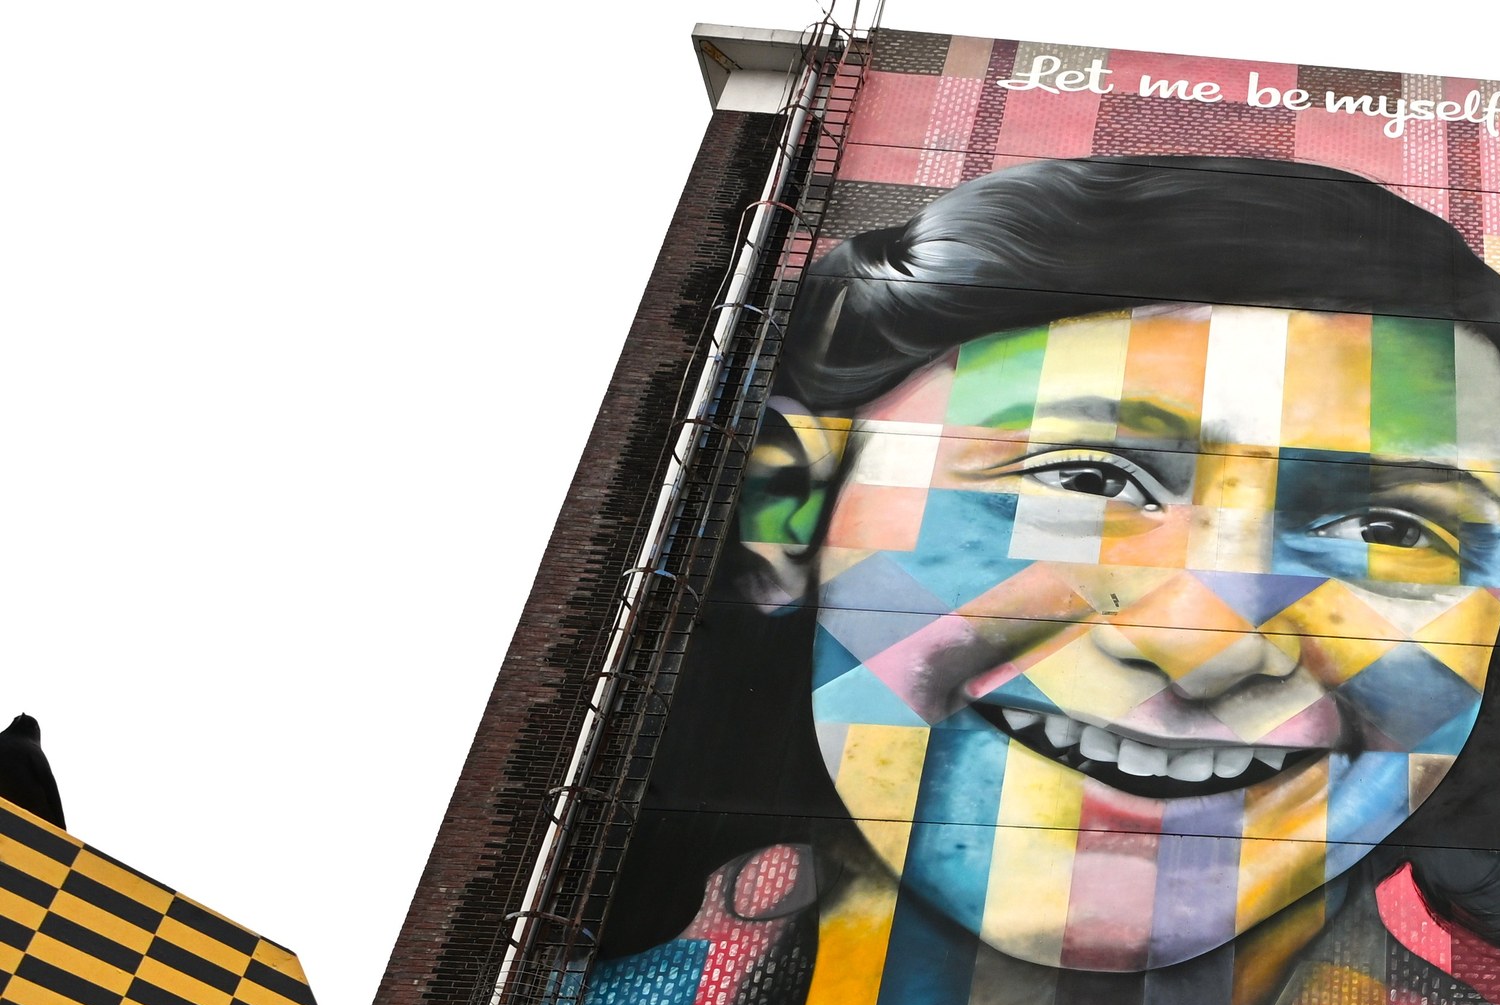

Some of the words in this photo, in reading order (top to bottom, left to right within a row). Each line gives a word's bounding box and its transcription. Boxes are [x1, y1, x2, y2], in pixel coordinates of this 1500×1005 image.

[997, 55, 1113, 97] Let
[1138, 73, 1224, 103] me
[1247, 71, 1311, 112] be
